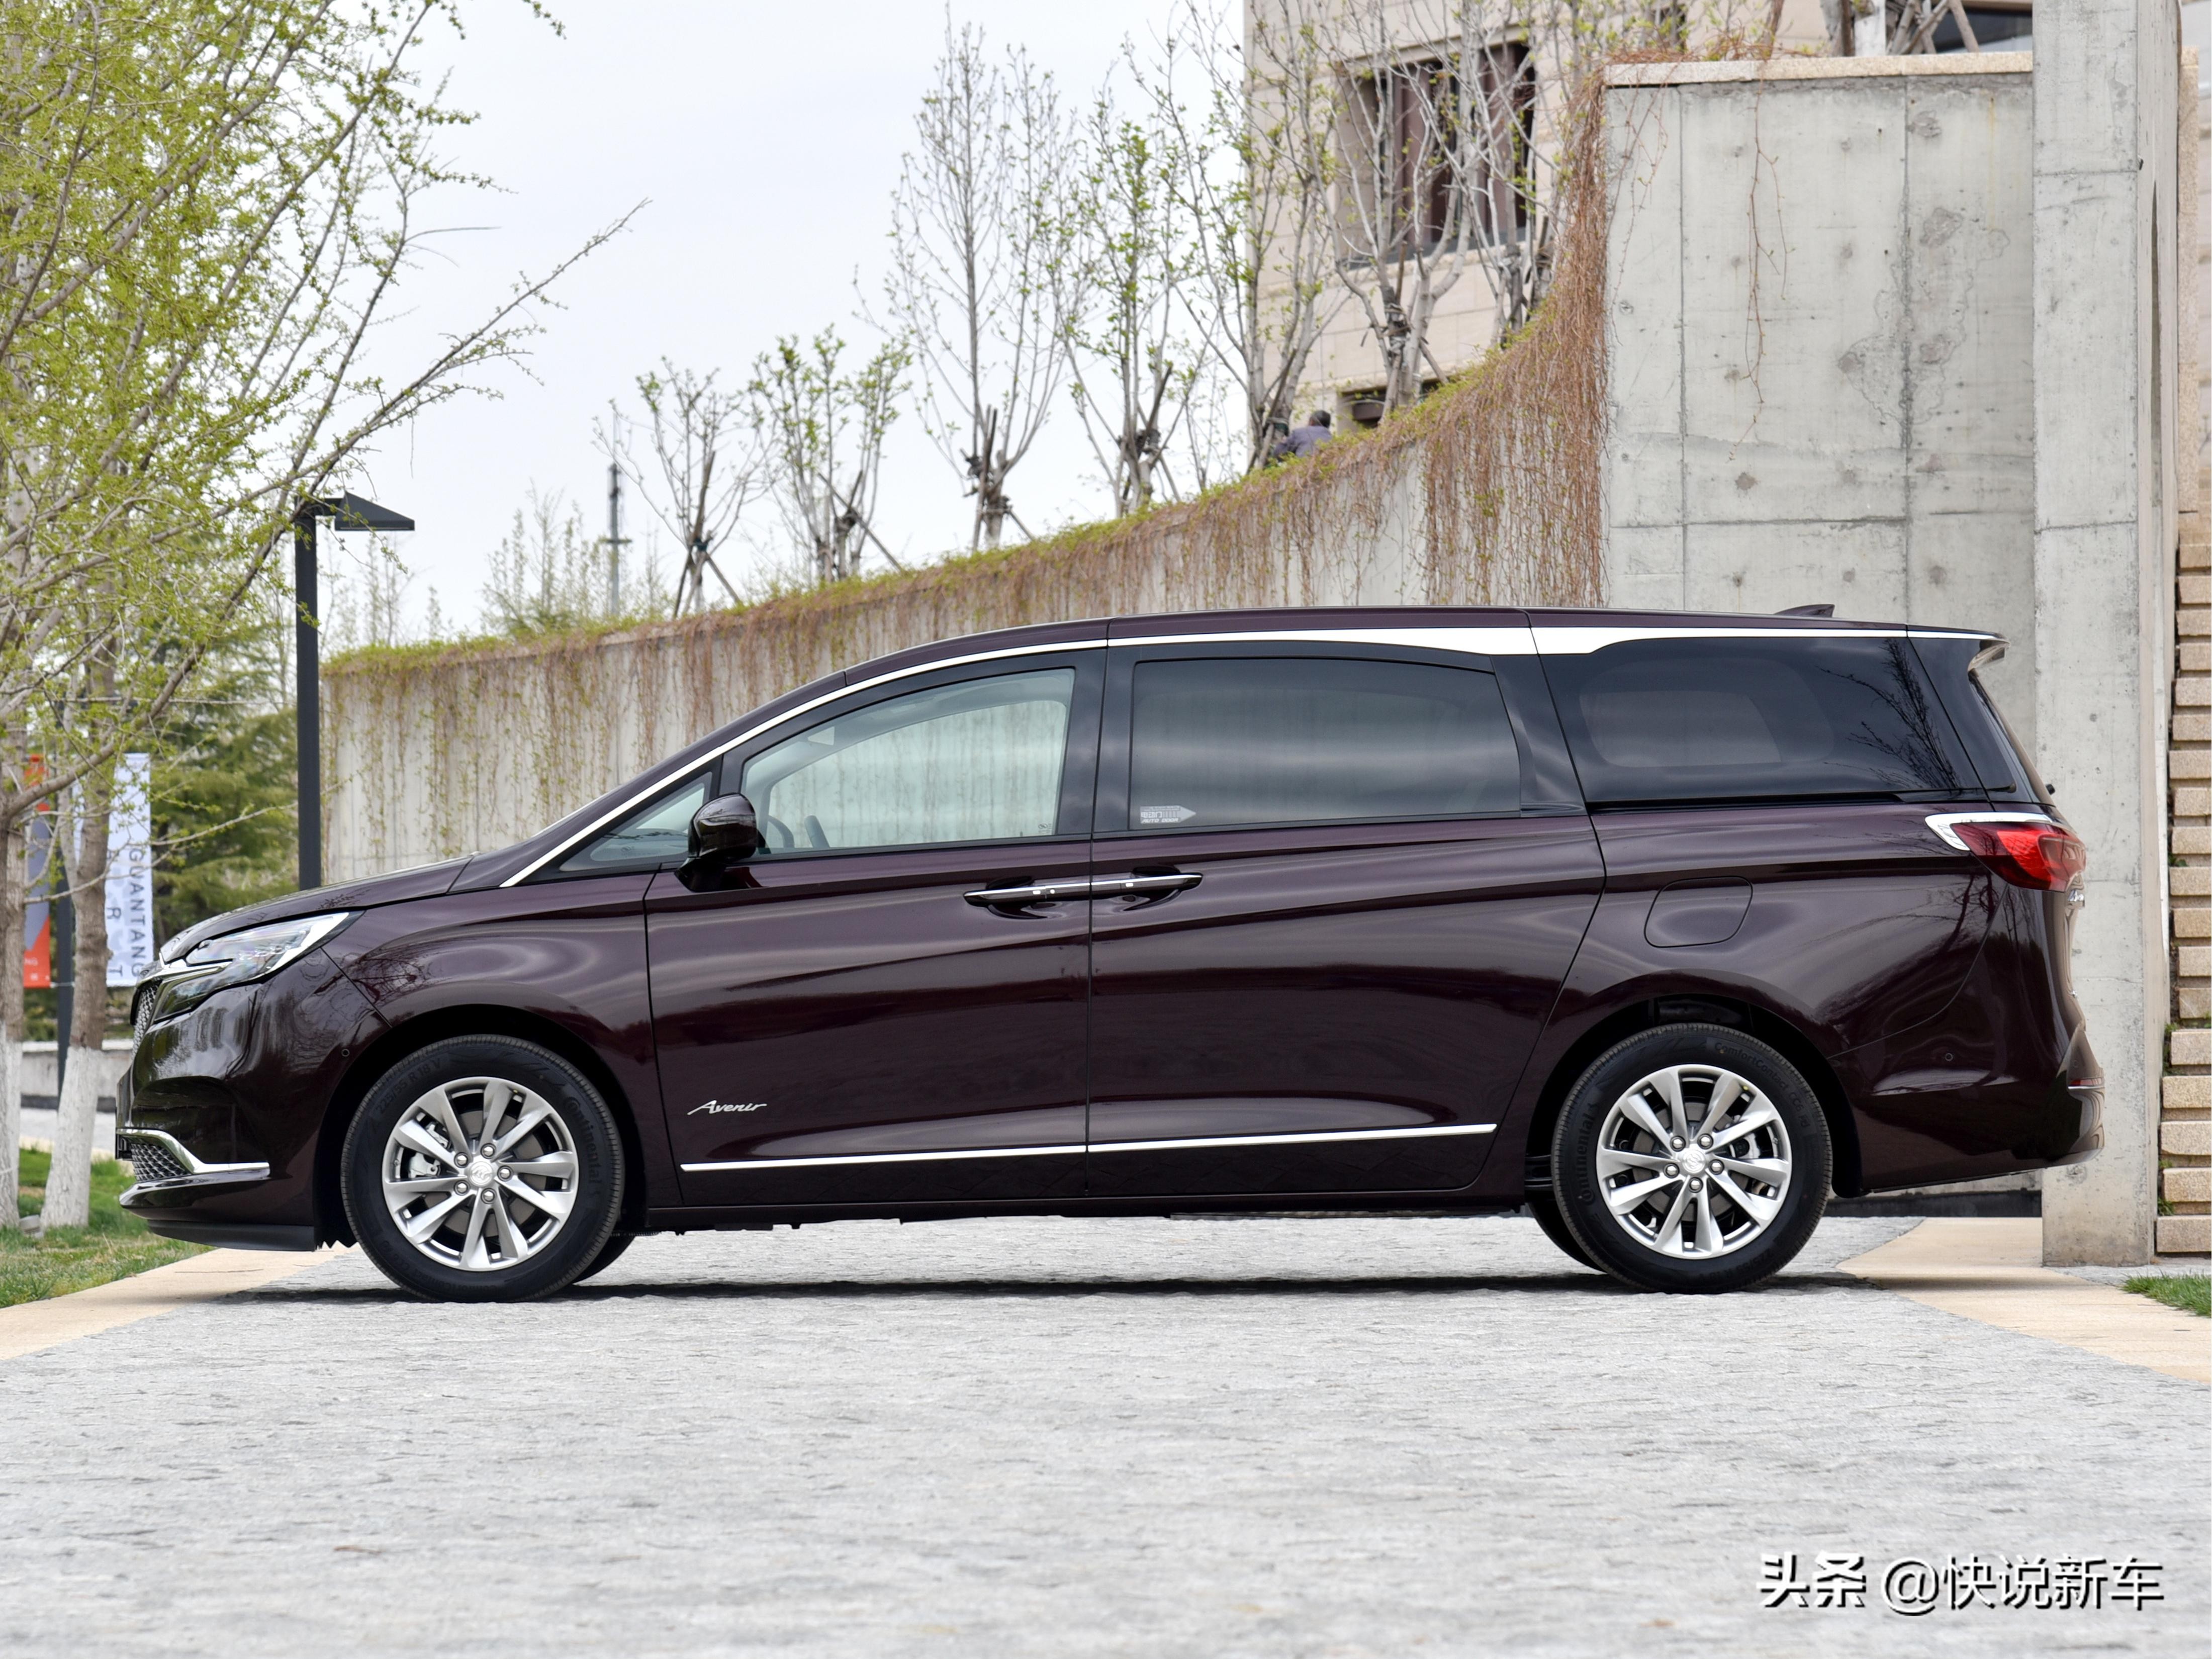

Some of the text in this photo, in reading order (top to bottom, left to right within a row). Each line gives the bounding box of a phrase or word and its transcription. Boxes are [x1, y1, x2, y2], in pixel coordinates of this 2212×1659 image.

[129, 848, 146, 977] GUANTANG
[376, 1079, 408, 1114] 225/55
[1714, 1042, 1789, 1091] ComfortContact
[563, 1096, 602, 1184] Continental
[687, 1100, 767, 1116] Avenir
[1576, 1113, 1597, 1207] Continental
